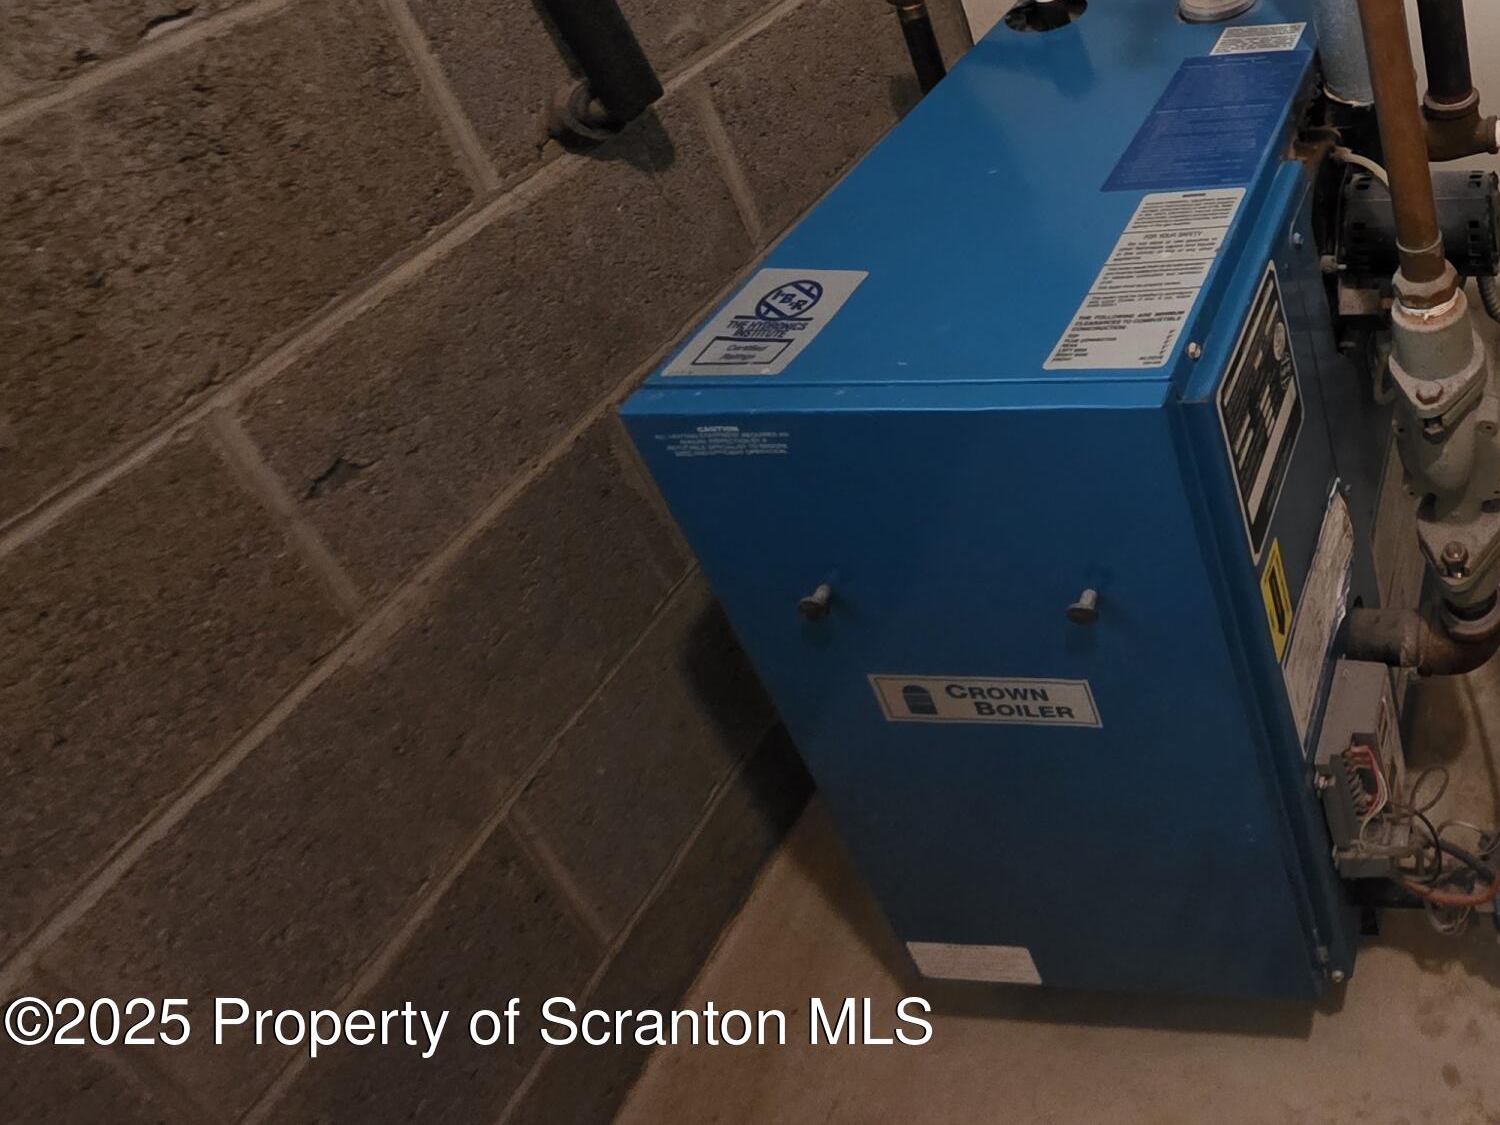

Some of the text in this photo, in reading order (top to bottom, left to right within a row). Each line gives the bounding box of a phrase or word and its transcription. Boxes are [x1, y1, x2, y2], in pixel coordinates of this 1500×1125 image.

[726, 320, 810, 332] THE HYDRONICS
[733, 328, 790, 339] INSTITUTE
[945, 684, 1049, 702] CROWN
[974, 702, 1074, 719] BOILER
